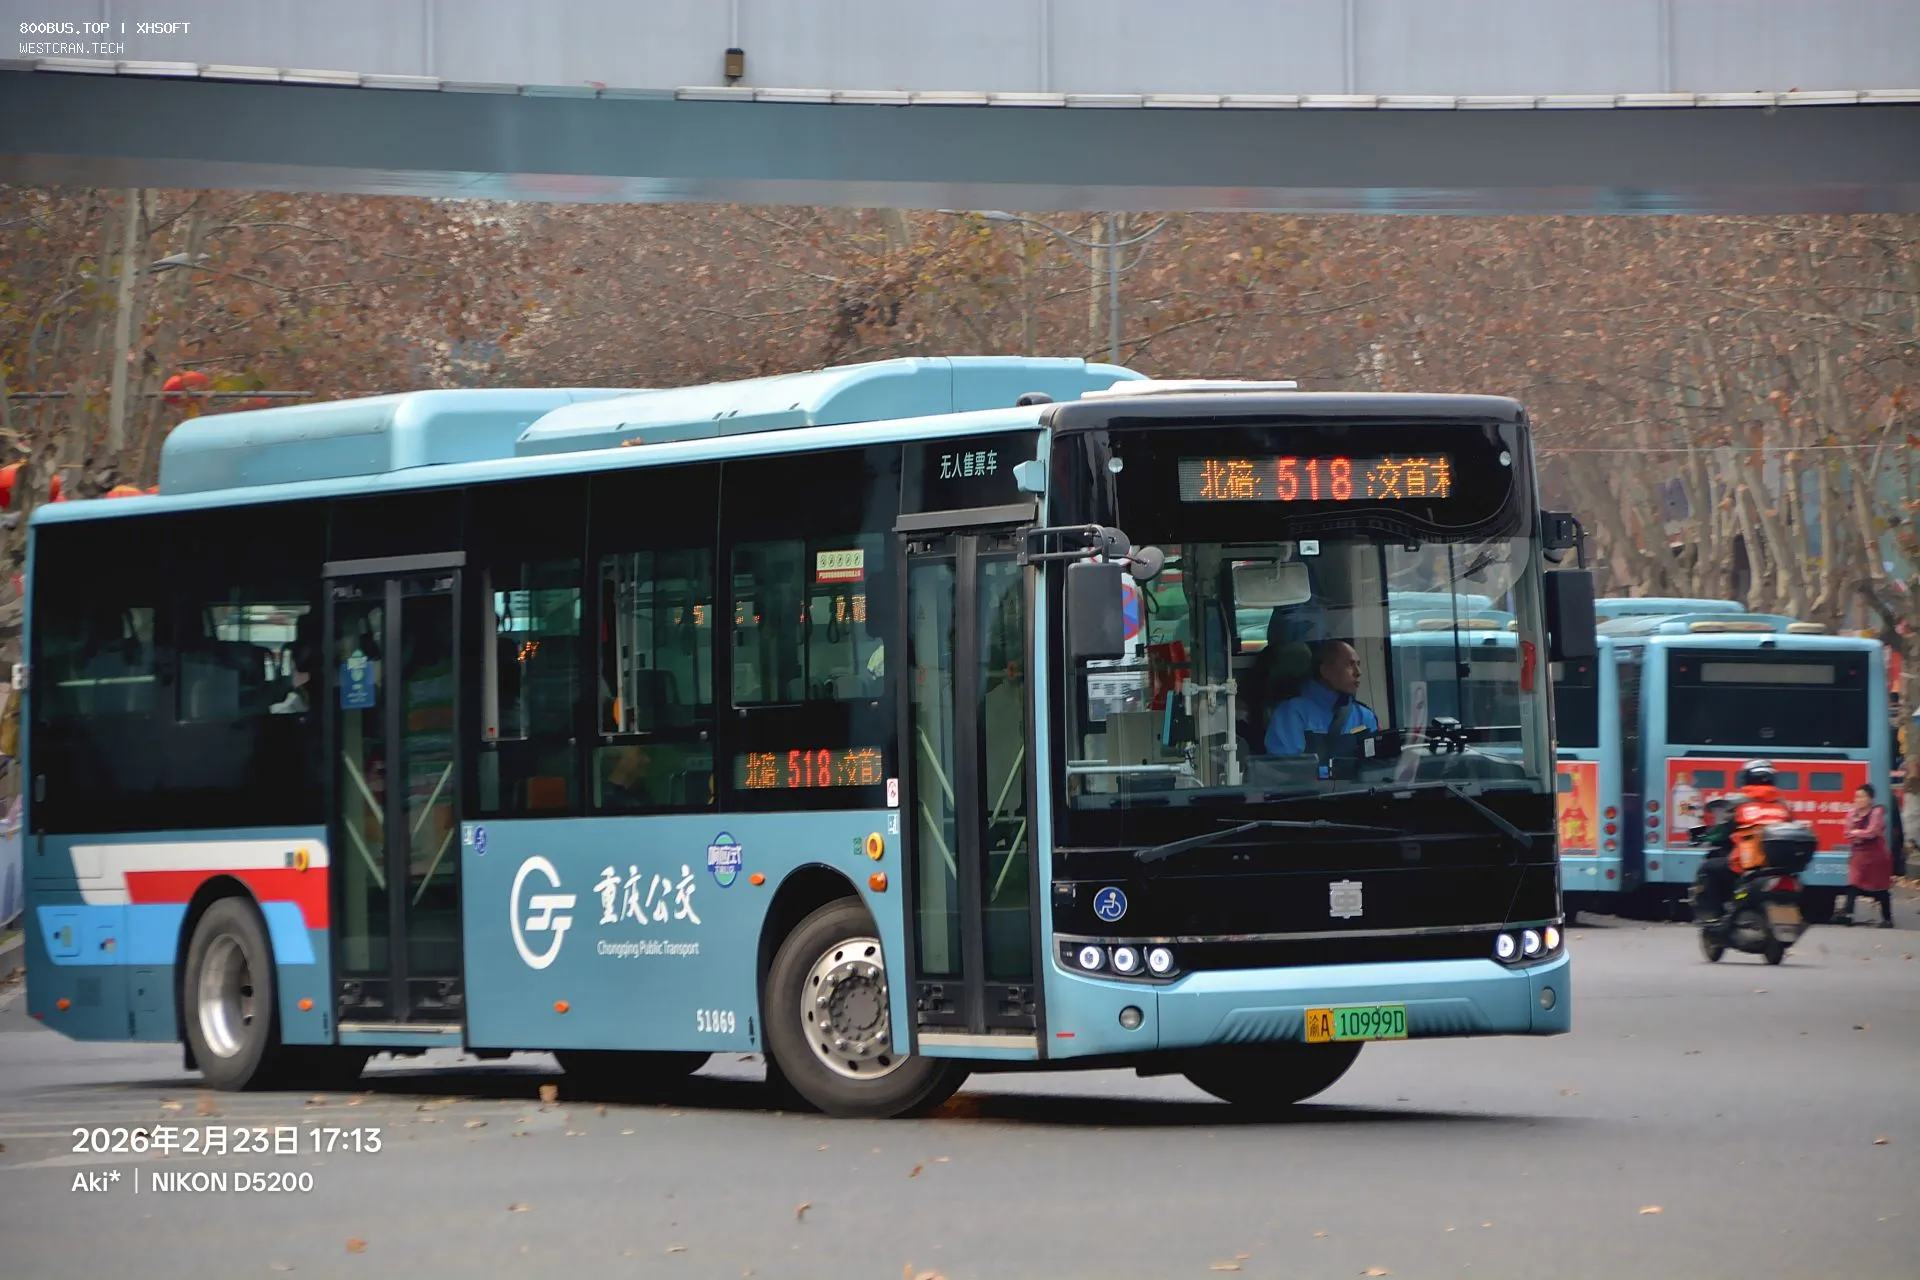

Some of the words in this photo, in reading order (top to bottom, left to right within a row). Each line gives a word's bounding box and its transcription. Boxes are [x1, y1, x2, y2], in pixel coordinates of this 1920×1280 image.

[940, 449, 998, 479] 无人售票车
[1277, 457, 1352, 501] 518
[788, 749, 831, 788] 518
[593, 864, 701, 925] 重庆公交
[597, 940, 639, 958] Chongqing
[640, 940, 662, 955] Public
[663, 940, 699, 958] Transport
[696, 1008, 735, 1034] 51869
[1309, 1014, 1330, 1037] 渝A
[1340, 1010, 1404, 1036] 10999D
